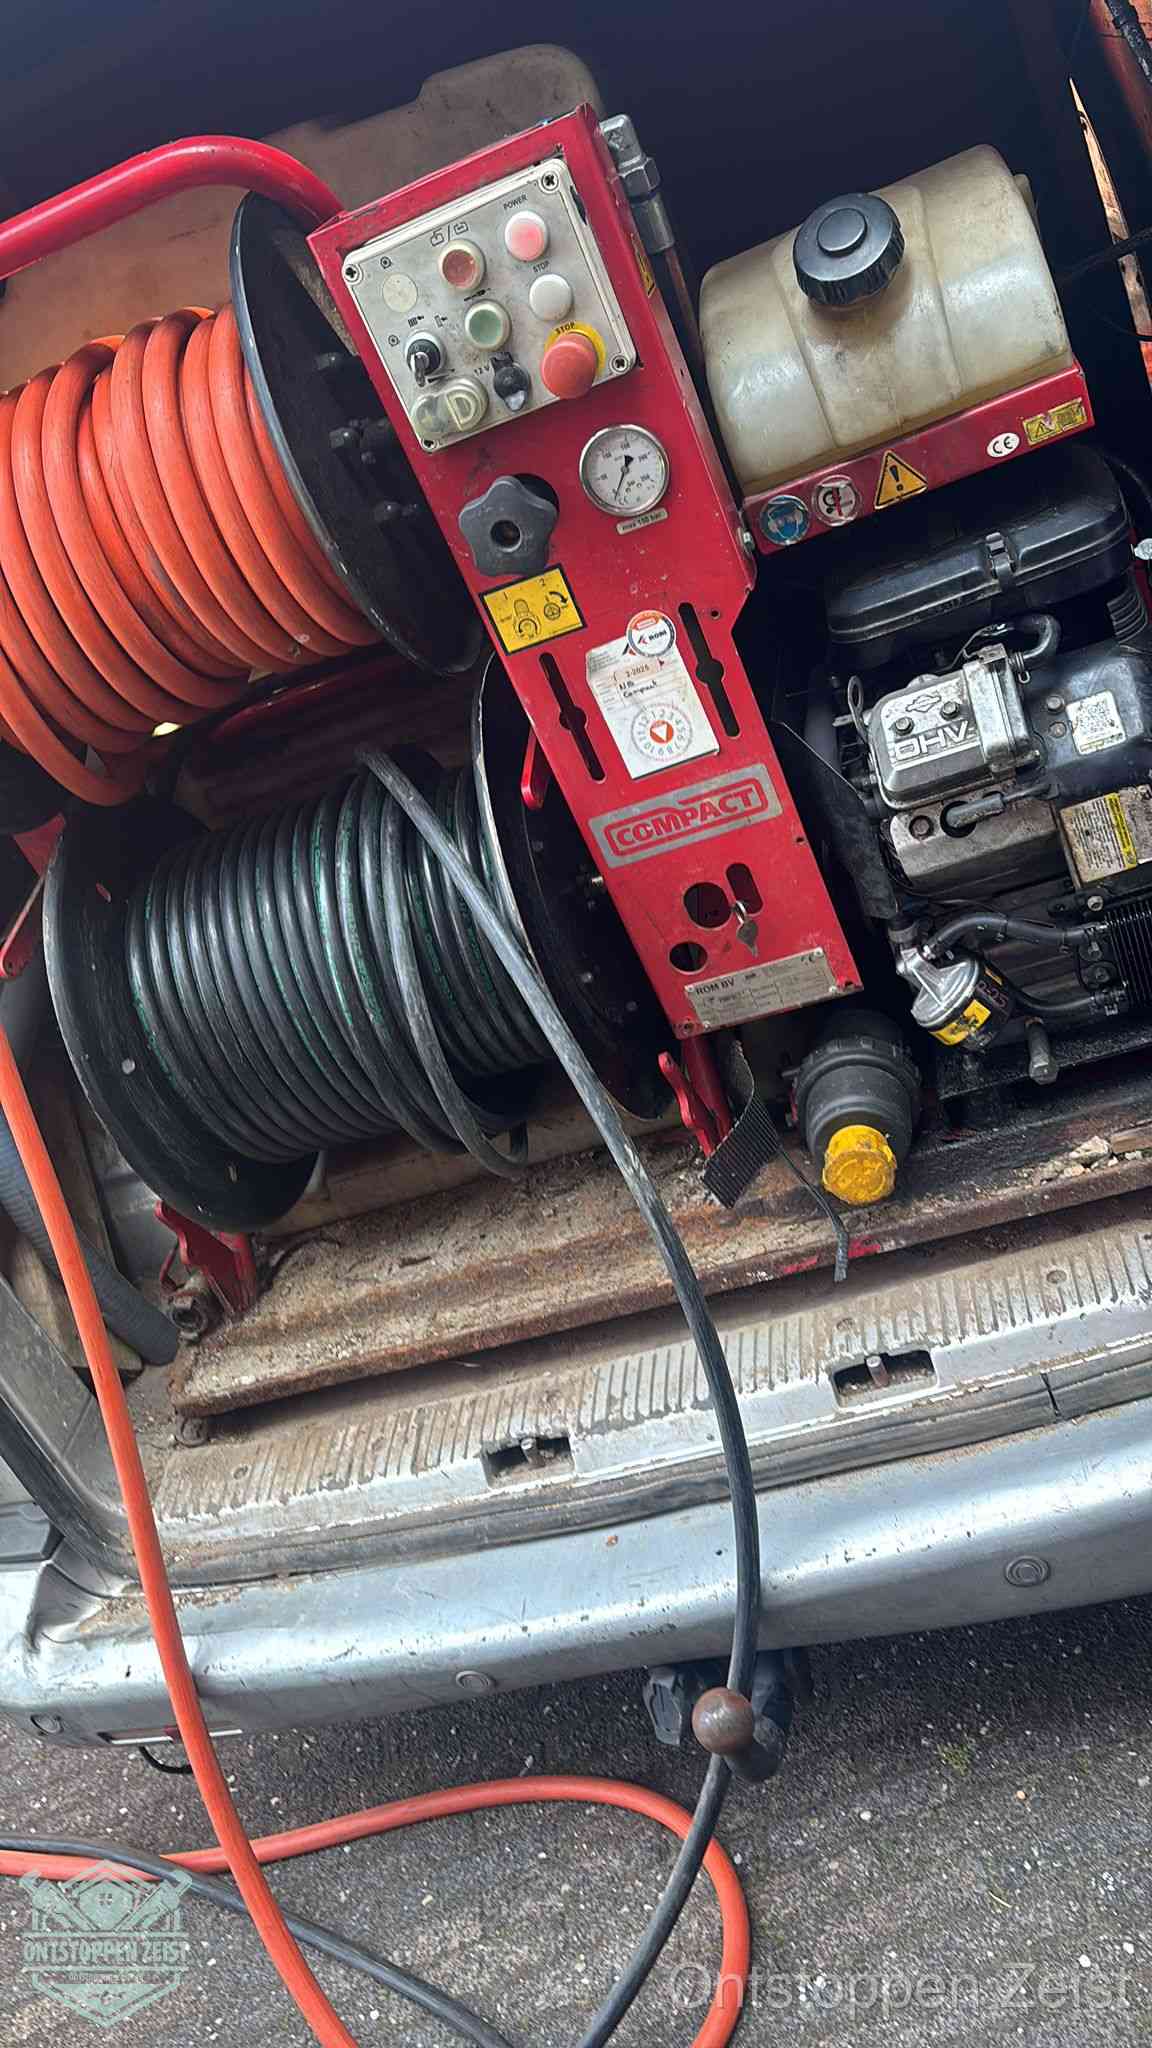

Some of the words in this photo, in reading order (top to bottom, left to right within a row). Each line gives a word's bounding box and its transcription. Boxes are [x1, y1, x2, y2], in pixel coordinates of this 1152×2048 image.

[503, 193, 528, 210] POWER
[532, 260, 550, 273] STOP
[555, 322, 576, 335] STOP
[992, 436, 1013, 454] CE
[894, 719, 969, 760] OHV
[615, 787, 754, 847] COMPACT
[695, 983, 720, 995] ROM
